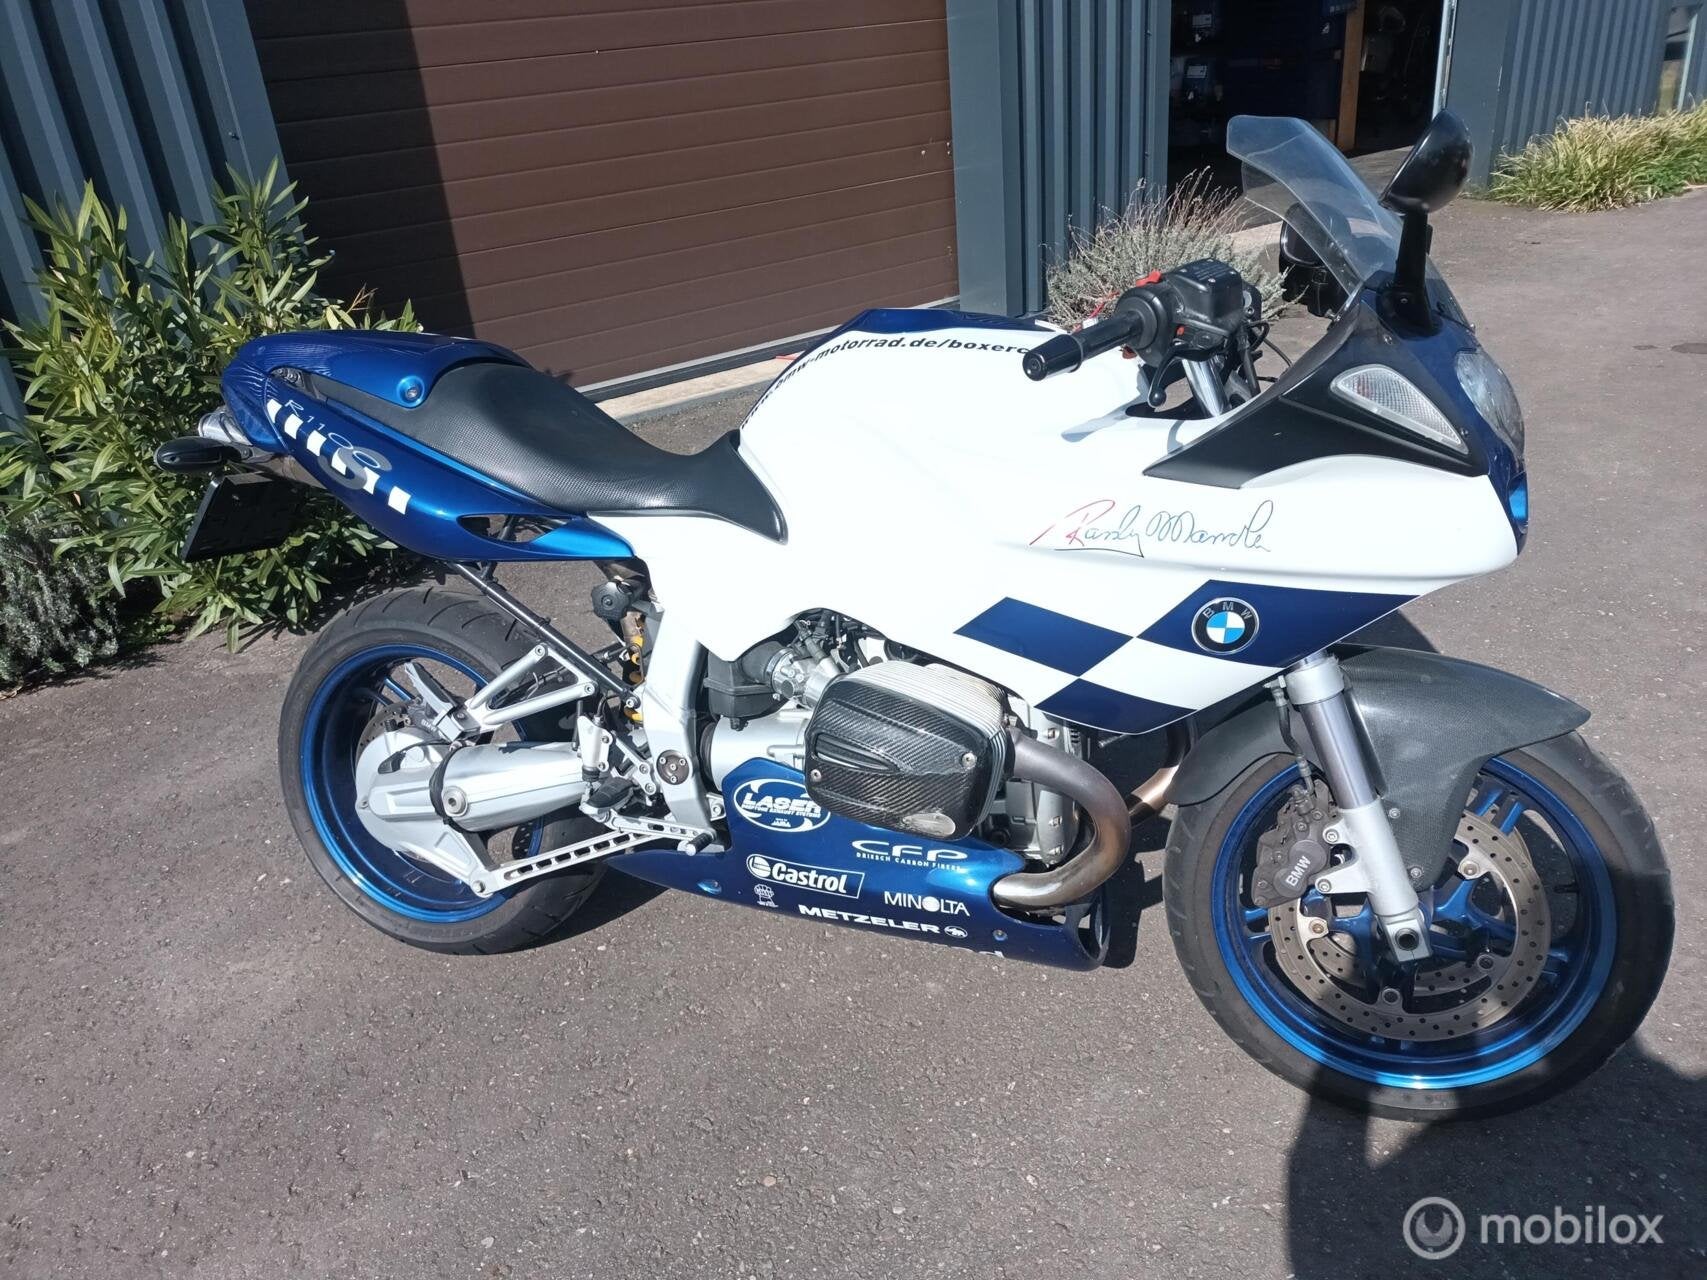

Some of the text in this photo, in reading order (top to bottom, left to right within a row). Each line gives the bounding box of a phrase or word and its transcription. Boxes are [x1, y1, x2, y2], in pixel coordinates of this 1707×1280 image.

[1202, 601, 1253, 620] BMW
[741, 793, 822, 814] LASER
[851, 840, 968, 862] CFP
[894, 855, 930, 867] CARBON
[772, 862, 848, 894] Castrol
[1285, 855, 1311, 887] BMW
[884, 891, 970, 917] MINOLTA
[798, 904, 941, 934] METZELER
